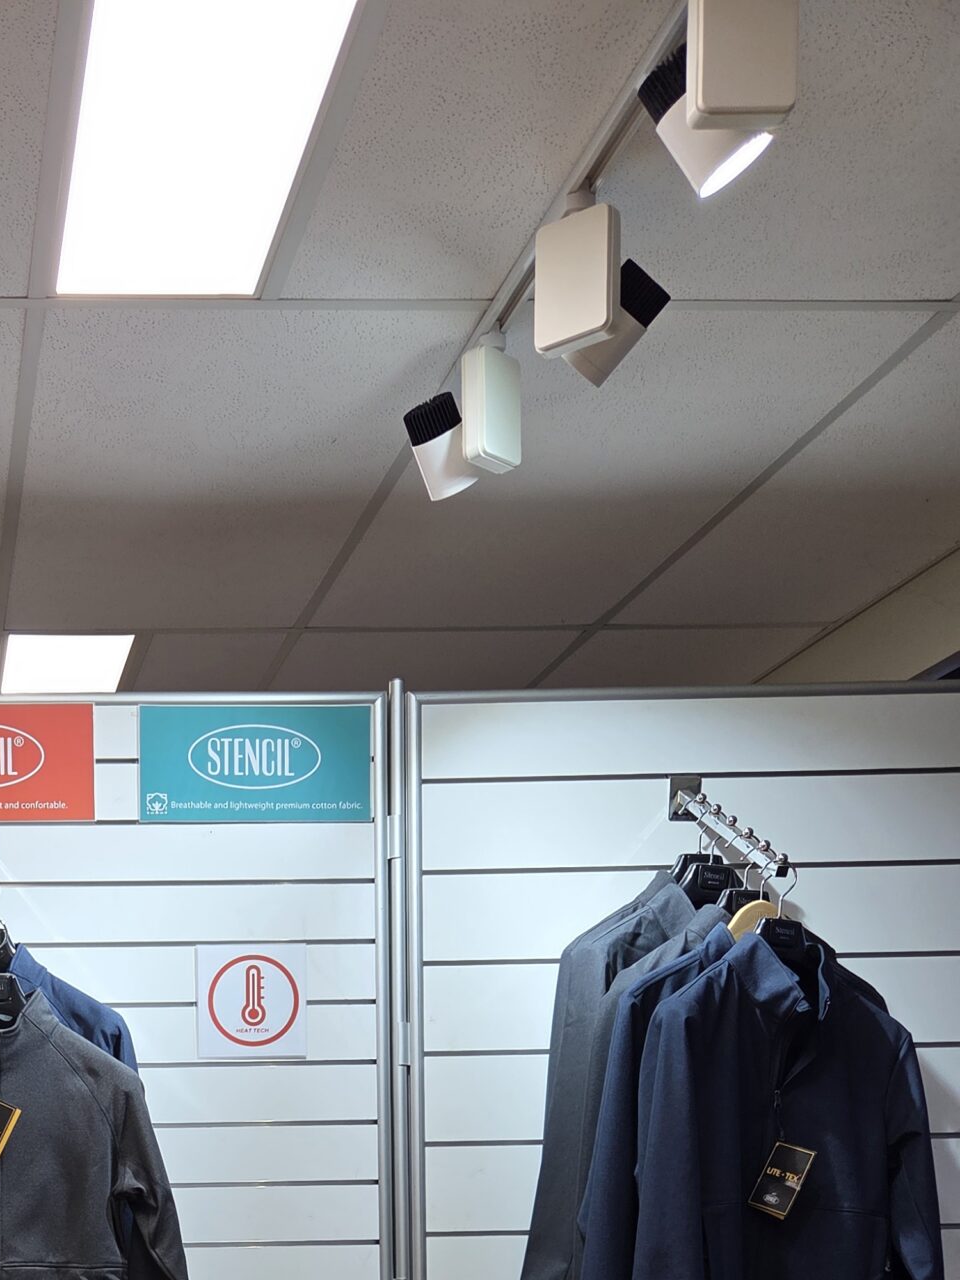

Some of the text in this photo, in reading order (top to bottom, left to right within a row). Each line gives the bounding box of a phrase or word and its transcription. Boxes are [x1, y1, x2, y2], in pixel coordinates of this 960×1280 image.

[4, 801, 20, 810] and
[170, 800, 364, 811] Breathable and lightweight premium cotton fabric.
